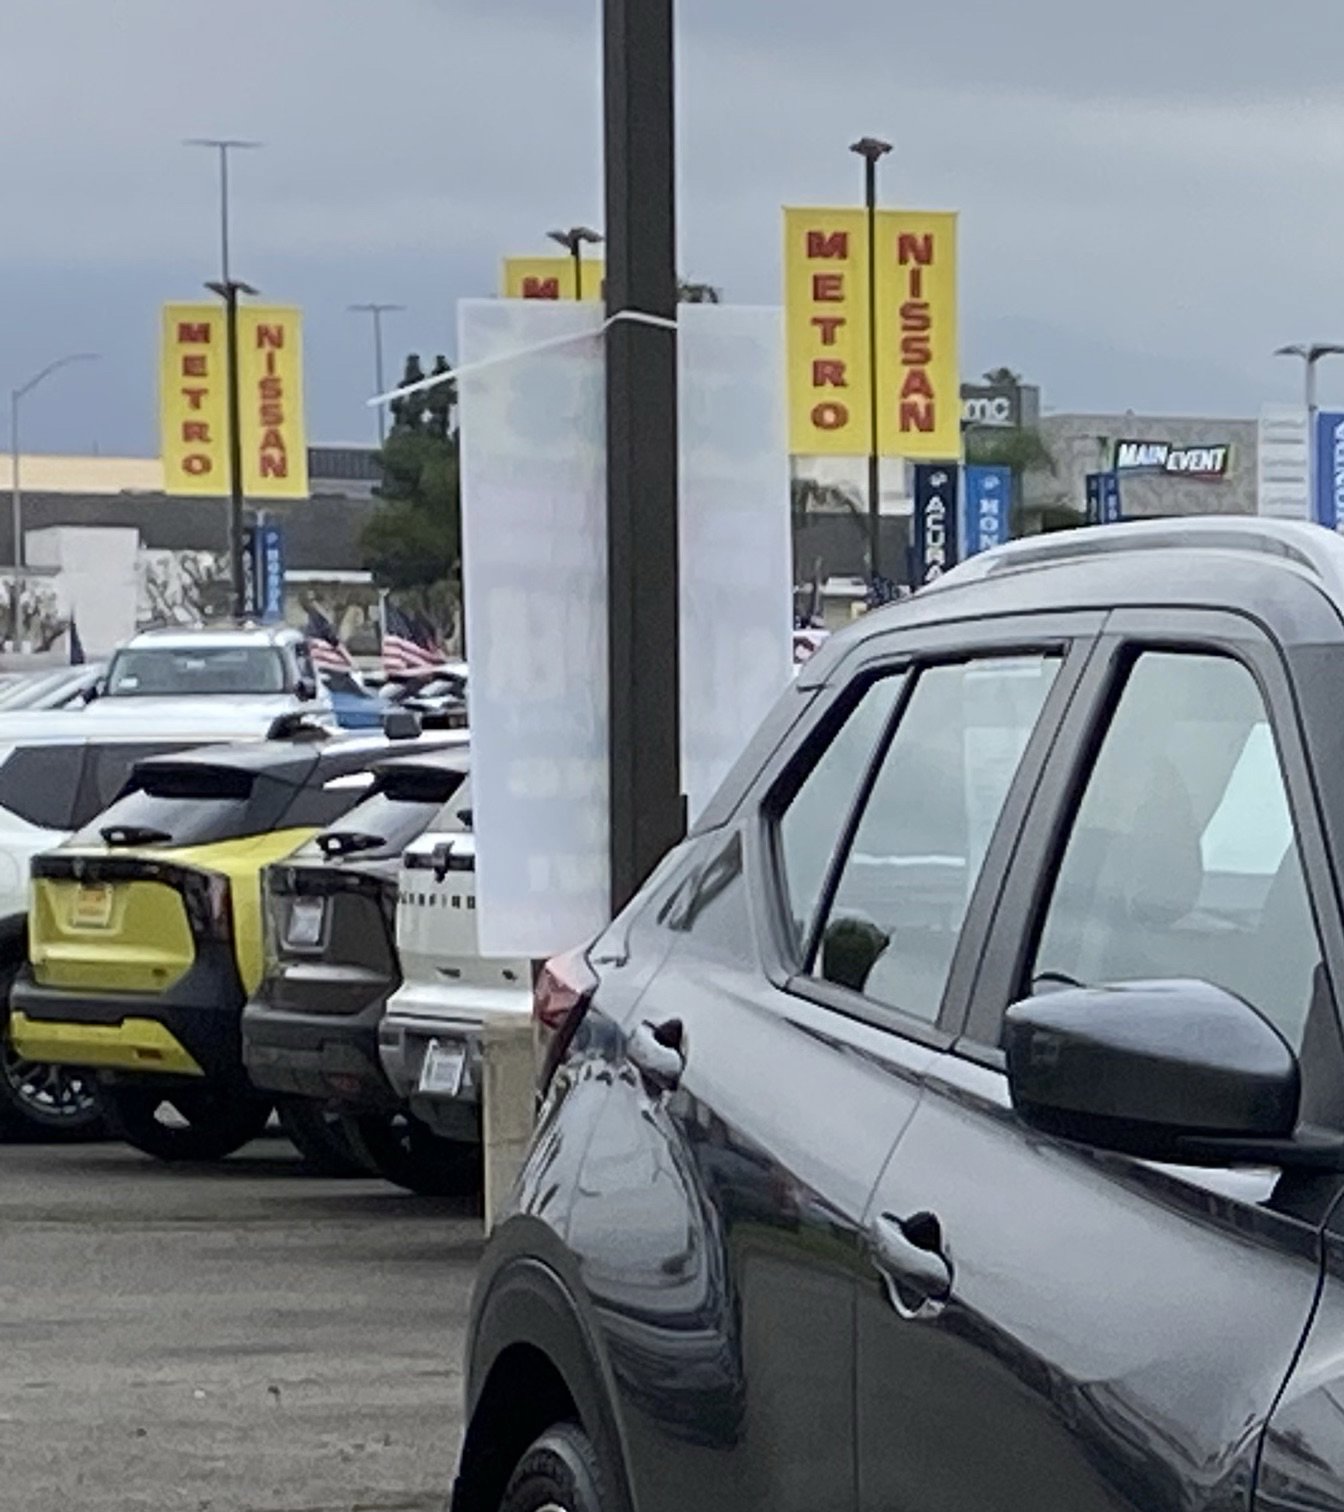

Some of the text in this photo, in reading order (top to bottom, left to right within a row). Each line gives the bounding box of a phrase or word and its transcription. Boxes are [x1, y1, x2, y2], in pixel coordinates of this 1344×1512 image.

[177, 322, 212, 476] METRO
[256, 324, 288, 478] NISSAN
[806, 230, 849, 430] METRO
[897, 233, 935, 432] NISSAN
[979, 499, 999, 550] HON
[1118, 444, 1226, 471] MAIN EVENT
[925, 496, 946, 582] ACURA
